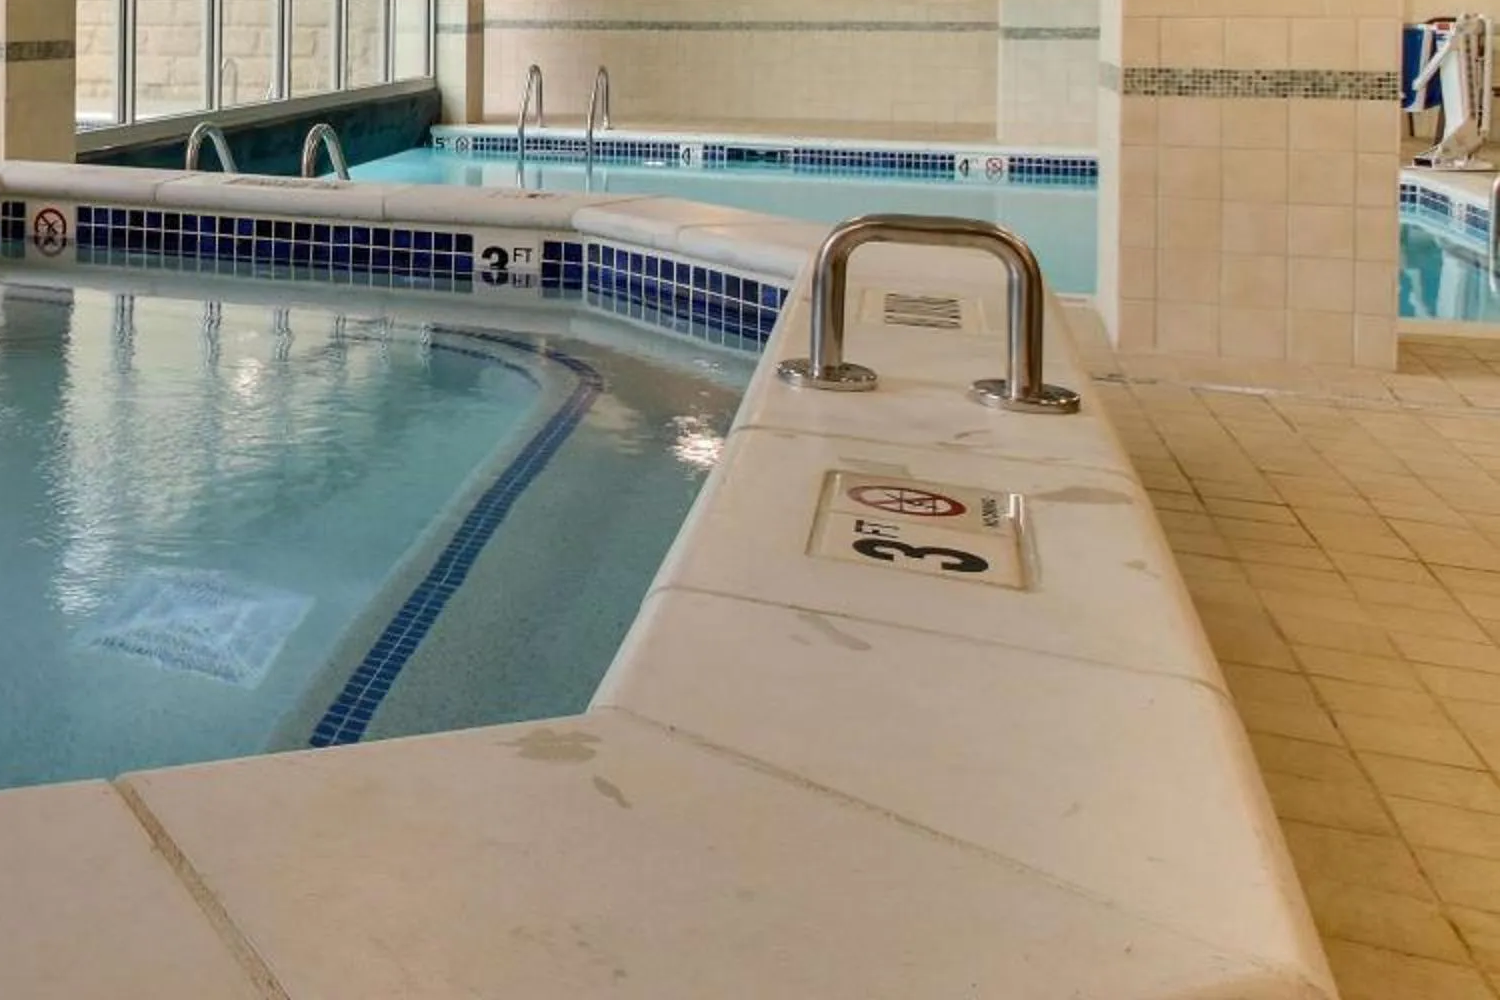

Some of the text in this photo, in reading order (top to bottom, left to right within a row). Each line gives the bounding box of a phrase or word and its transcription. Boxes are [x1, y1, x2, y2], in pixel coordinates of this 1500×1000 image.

[513, 248, 533, 264] FT
[852, 519, 989, 573] 3 FT
